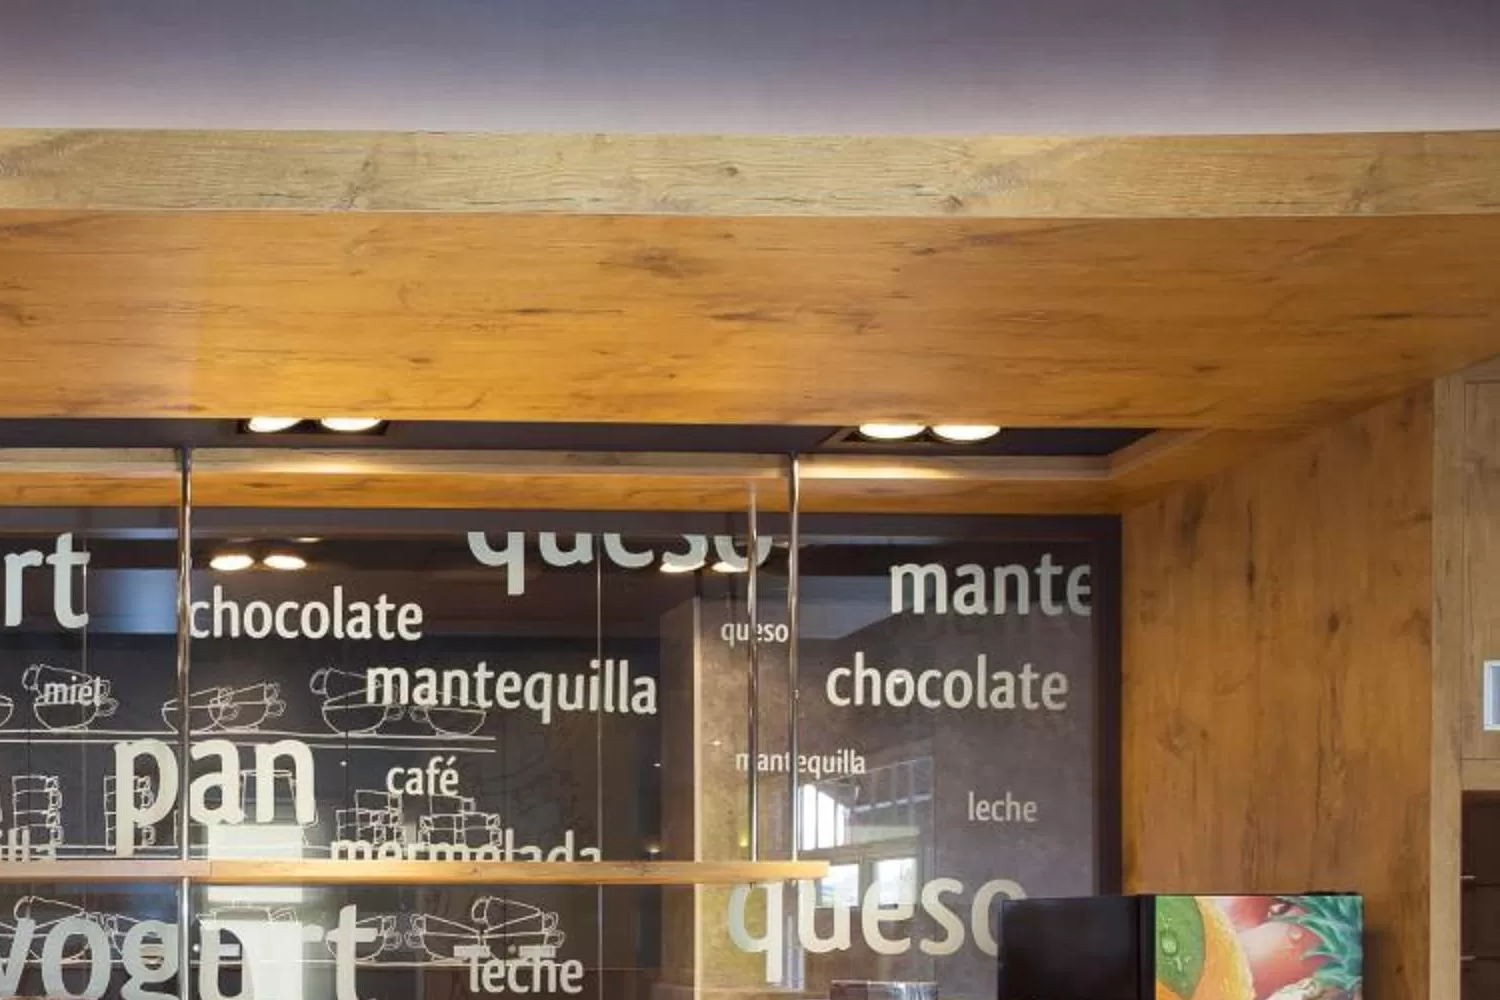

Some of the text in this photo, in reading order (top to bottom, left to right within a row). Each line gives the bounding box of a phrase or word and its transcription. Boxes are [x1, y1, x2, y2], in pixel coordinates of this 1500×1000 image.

[890, 553, 1093, 616] mante
[189, 585, 424, 640] chocolate
[44, 676, 103, 707] miel
[366, 659, 657, 725] mantequilla
[826, 651, 1069, 711] chocolate
[113, 737, 317, 857] pan
[385, 755, 460, 797] café
[967, 791, 1039, 823] leche
[469, 944, 585, 995] leche
